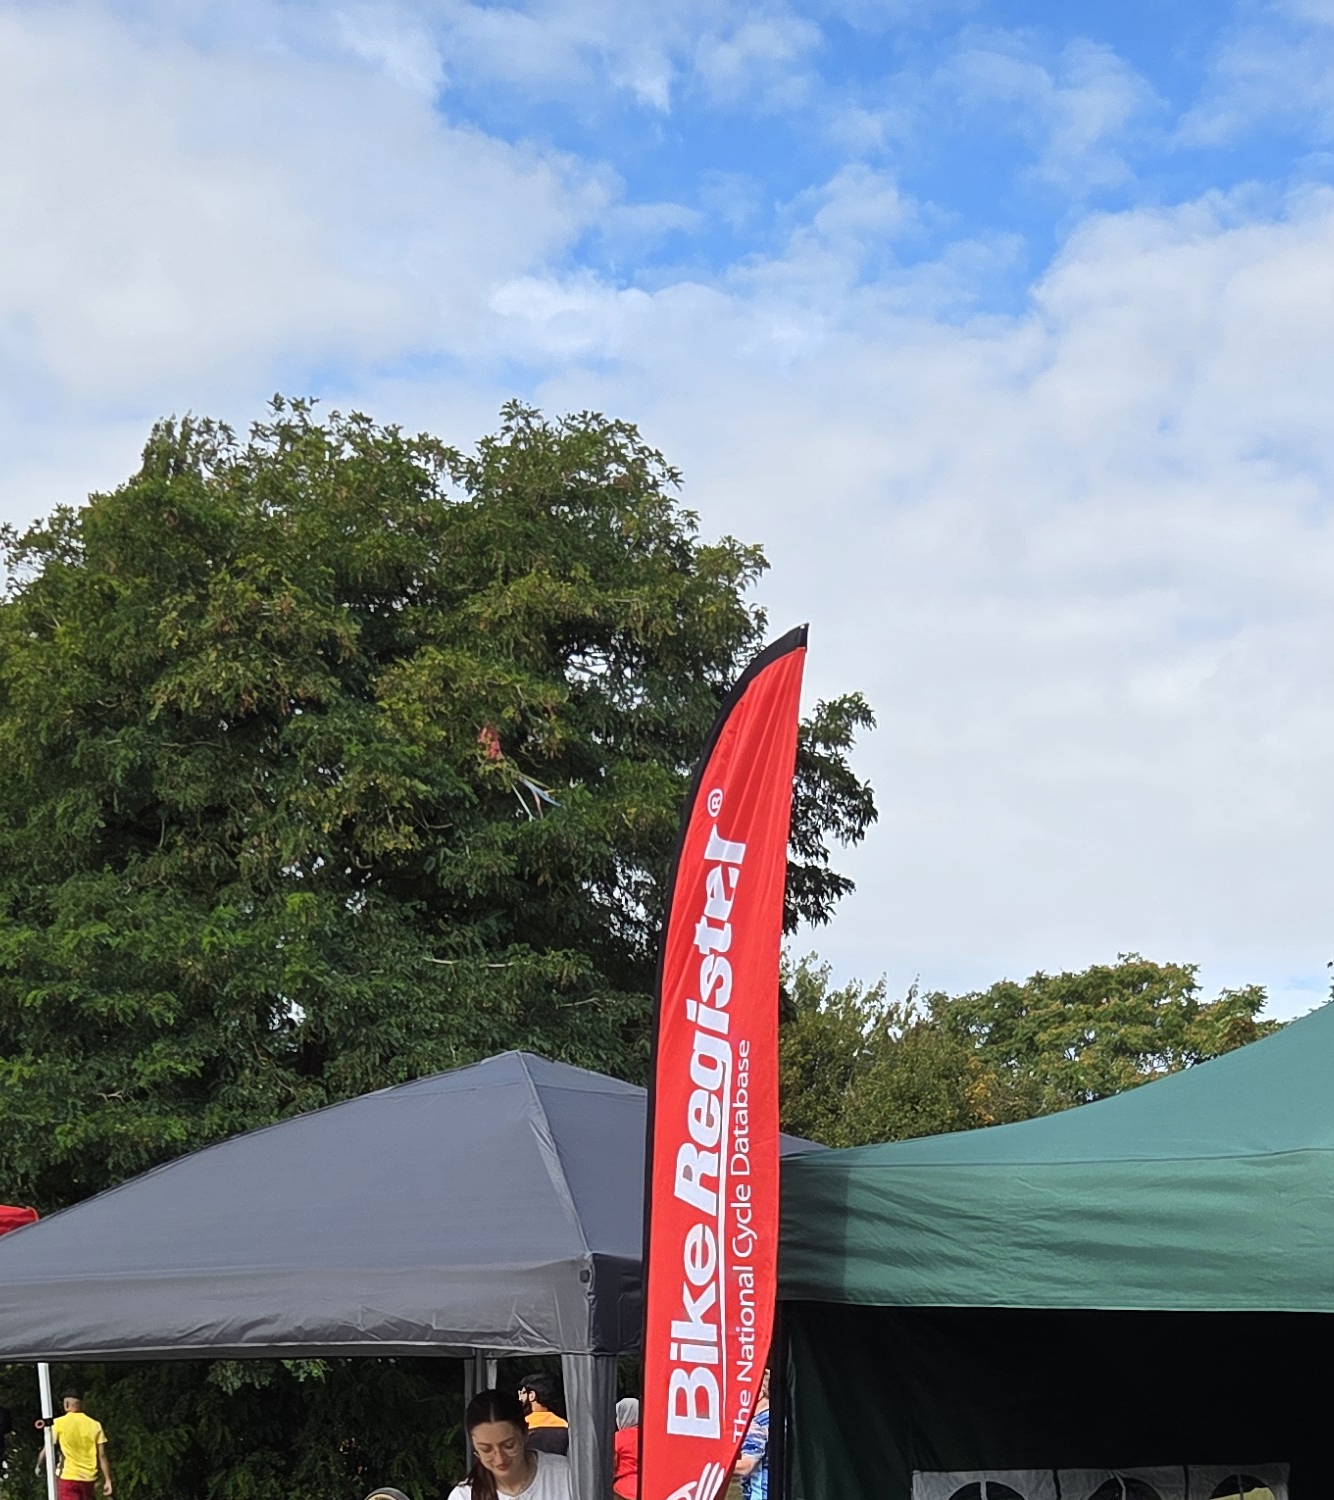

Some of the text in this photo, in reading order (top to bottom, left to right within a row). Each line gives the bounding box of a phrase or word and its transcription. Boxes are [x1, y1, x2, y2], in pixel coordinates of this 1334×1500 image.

[667, 823, 747, 1439] BikeRegister
[729, 1038, 758, 1444] The National Cycle Database
